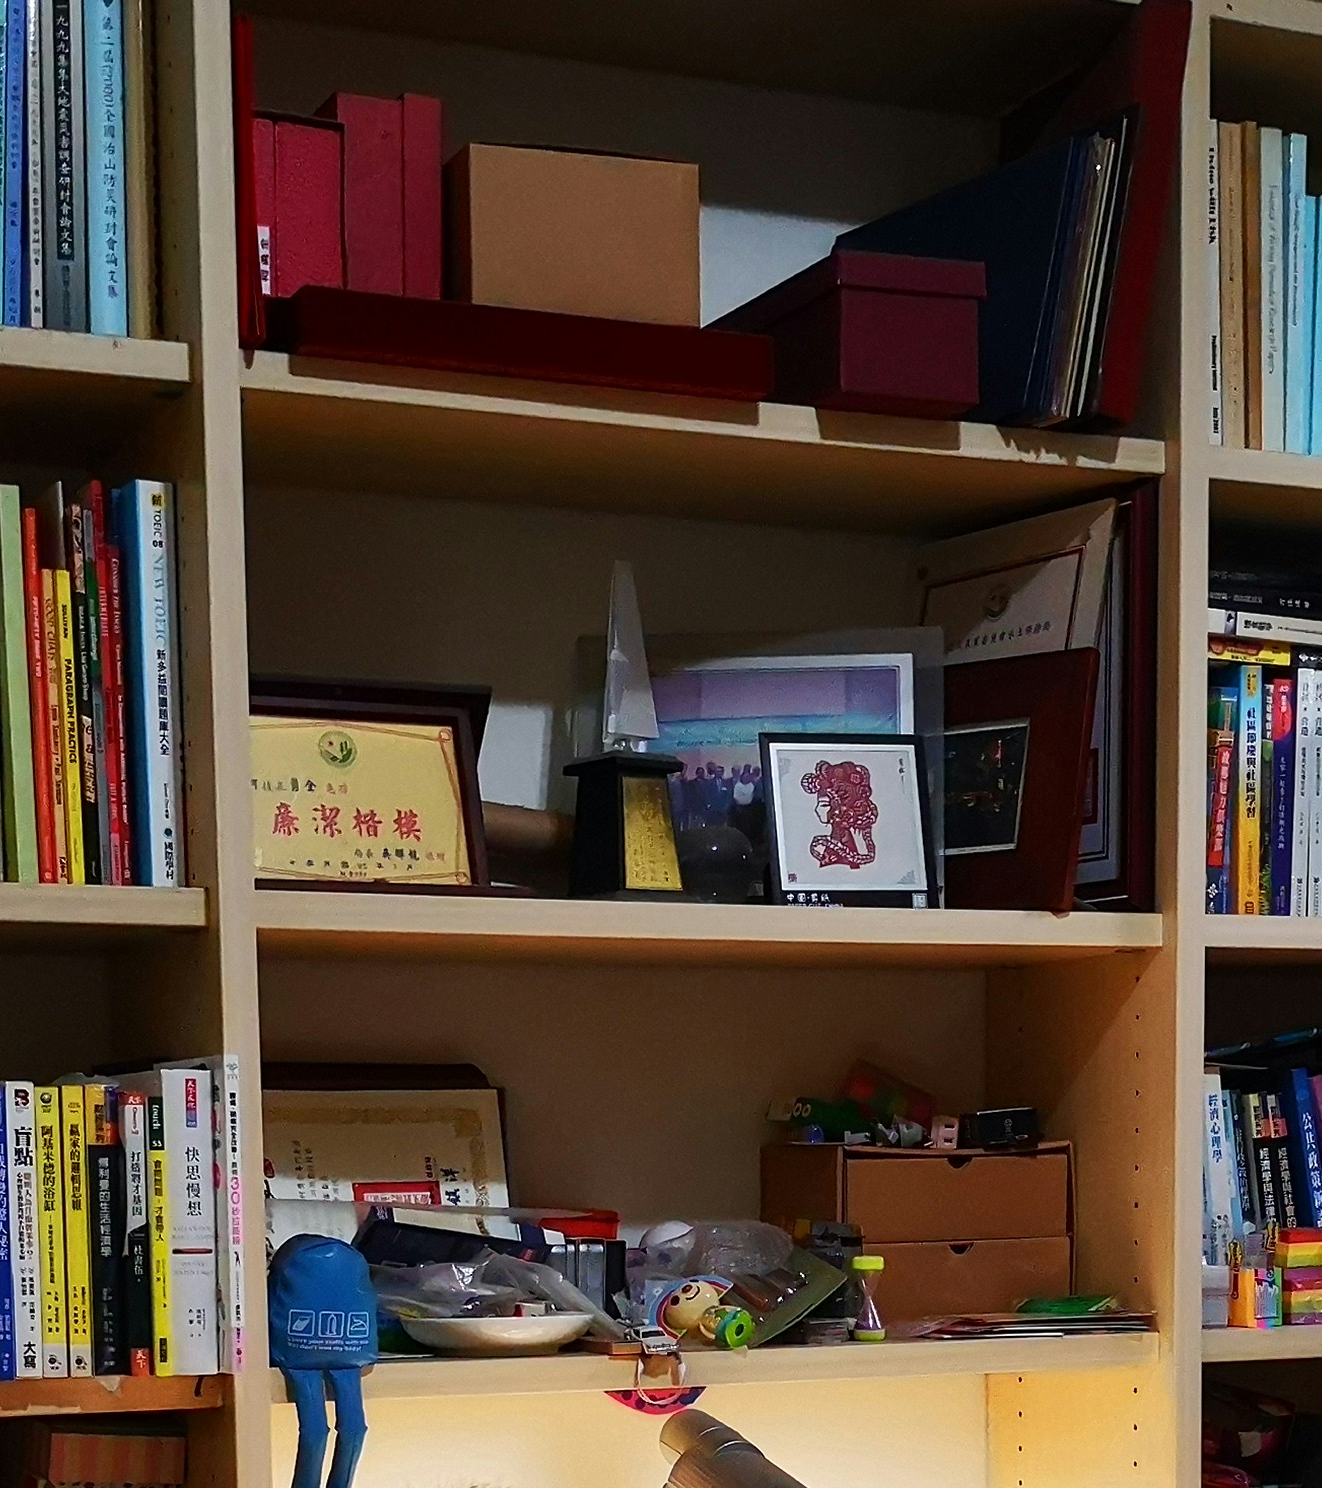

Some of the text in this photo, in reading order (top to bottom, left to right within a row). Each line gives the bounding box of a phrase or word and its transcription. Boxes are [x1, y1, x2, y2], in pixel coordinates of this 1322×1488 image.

[14, 1127, 34, 1167] 盲點
[185, 1147, 202, 1217] 快思慢想
